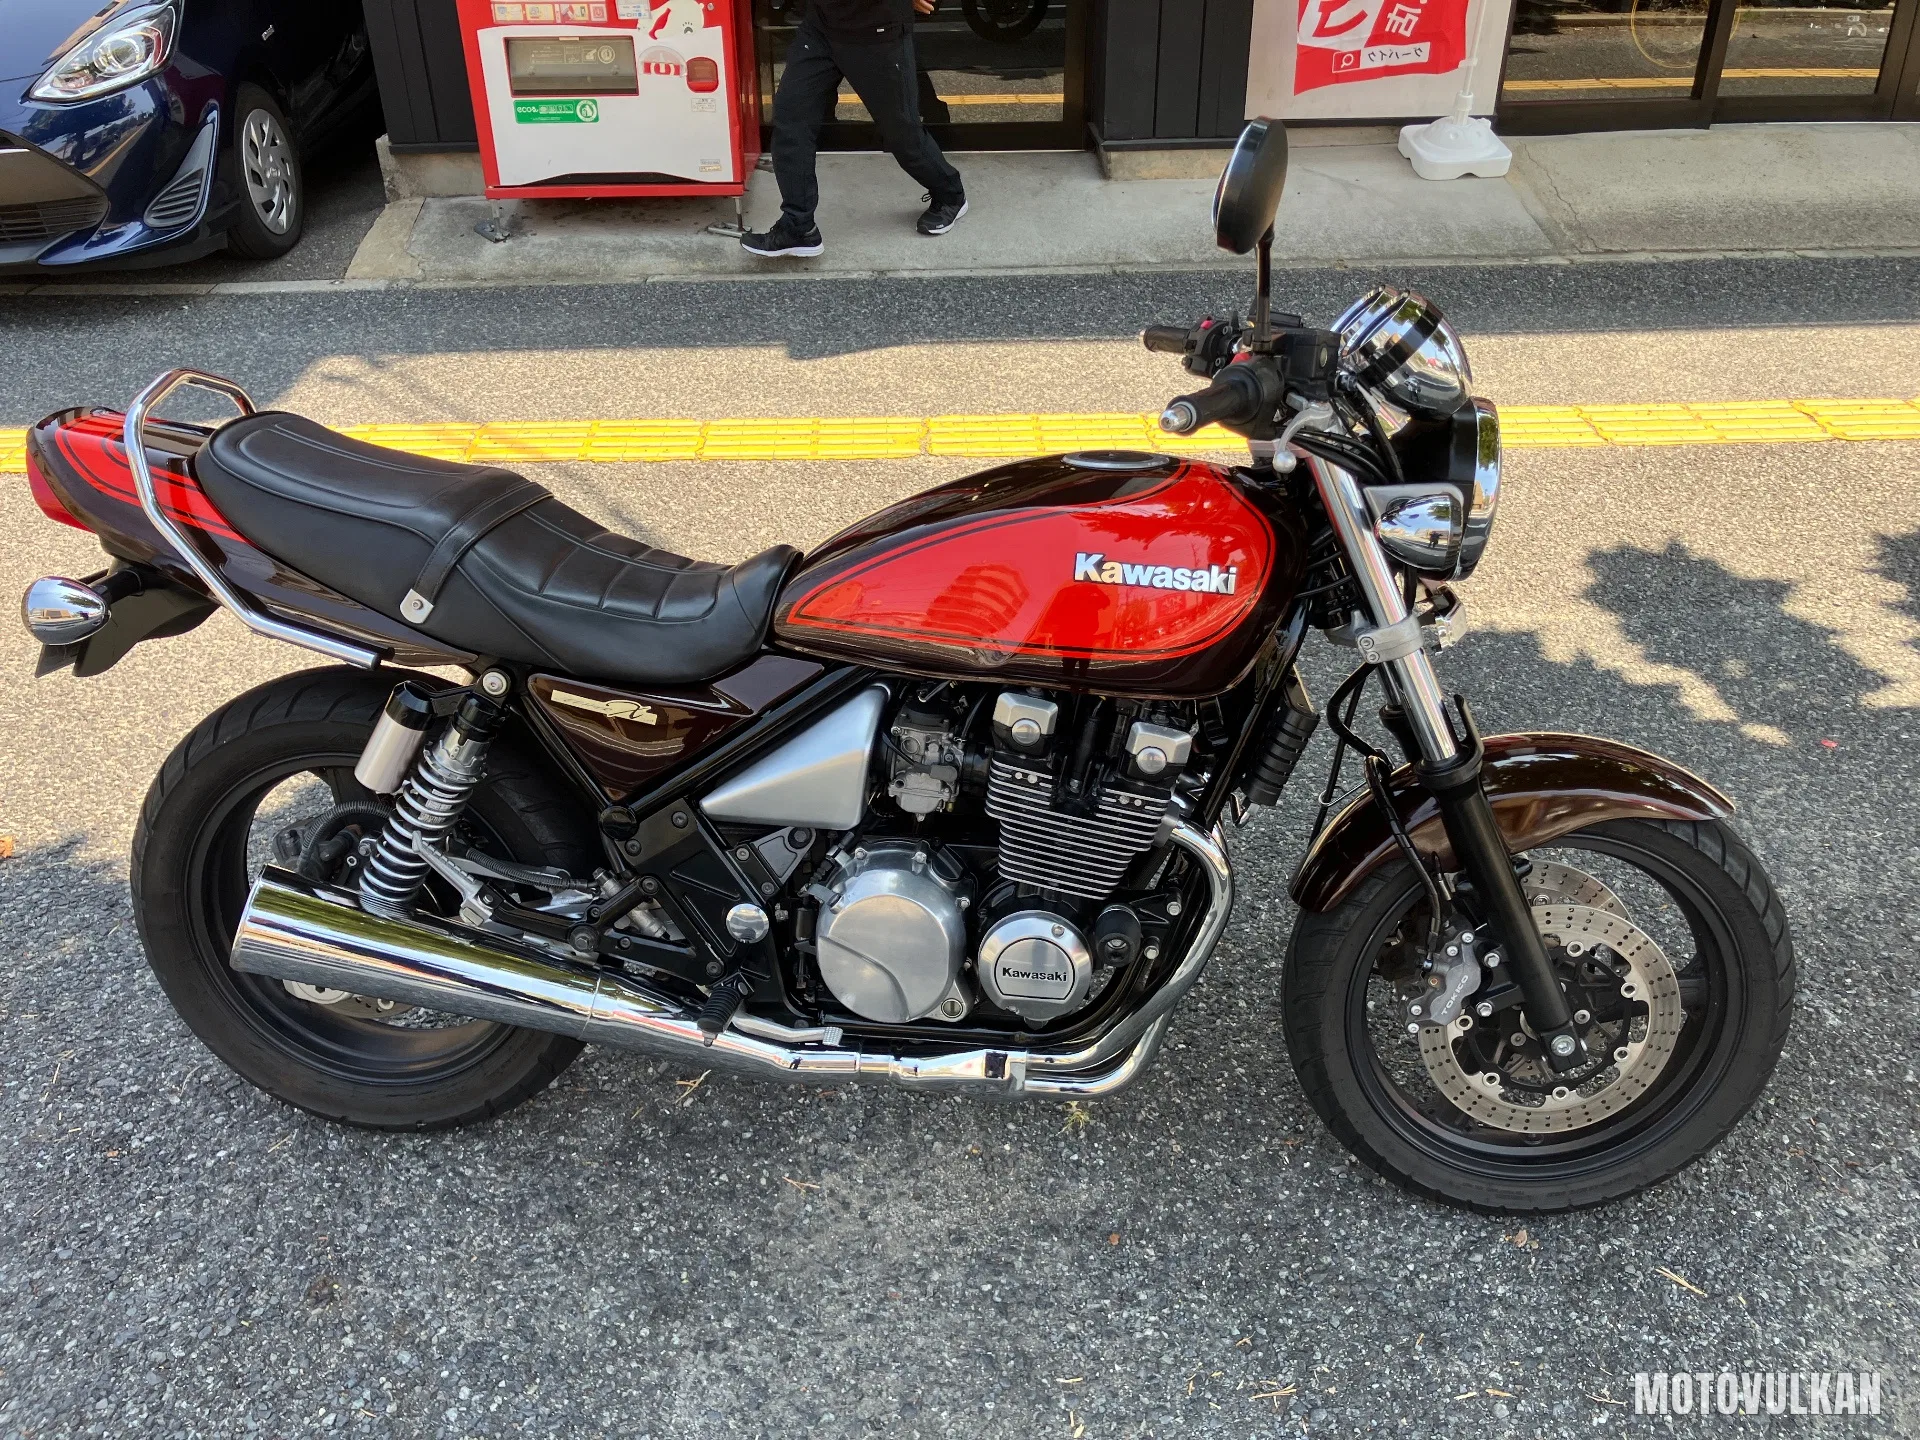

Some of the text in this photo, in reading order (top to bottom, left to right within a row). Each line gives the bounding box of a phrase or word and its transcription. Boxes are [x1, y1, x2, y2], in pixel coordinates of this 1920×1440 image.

[1074, 552, 1238, 595] Kawasaki
[1002, 967, 1068, 982] Kawasaki
[1441, 975, 1469, 1015] TOKICO
